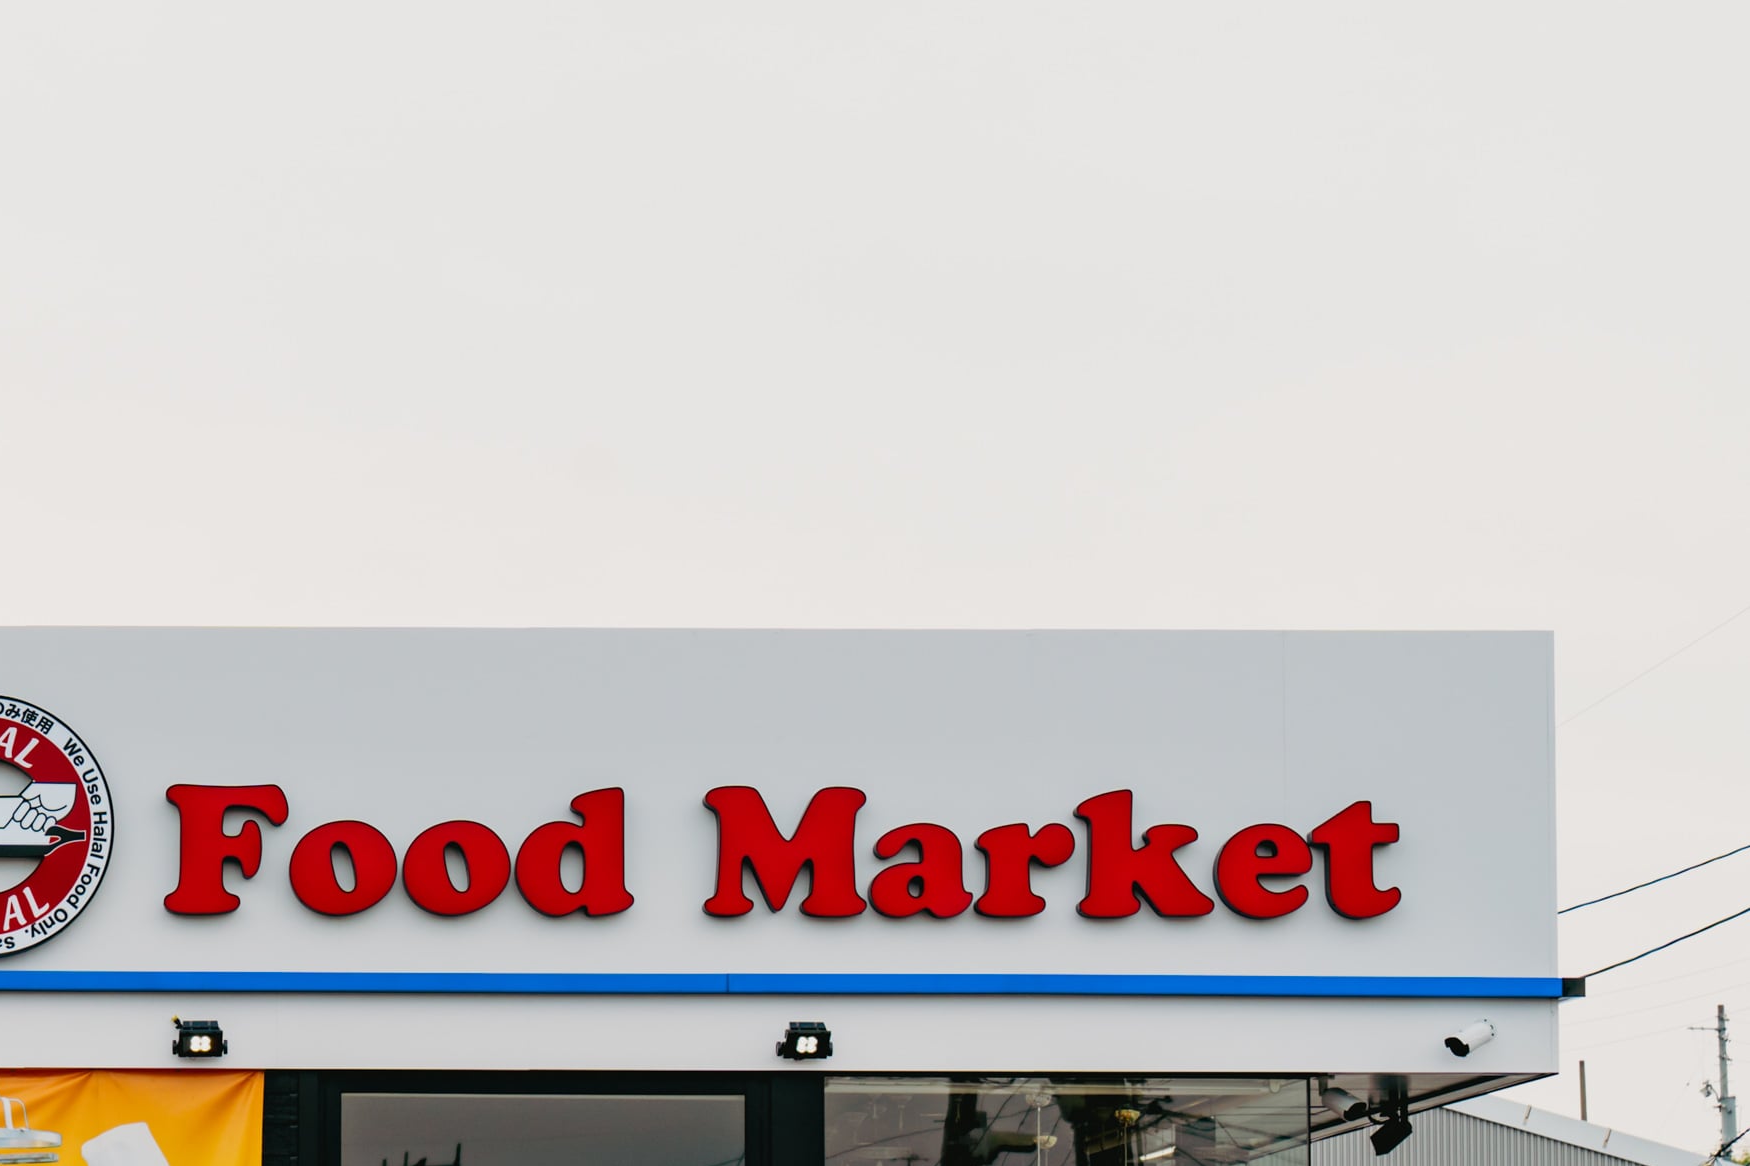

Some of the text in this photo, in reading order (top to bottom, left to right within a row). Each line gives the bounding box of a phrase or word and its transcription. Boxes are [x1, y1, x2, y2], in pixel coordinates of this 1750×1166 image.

[24, 737, 108, 938] We Use Halal Food Only.
[164, 783, 1402, 920] Food Market
